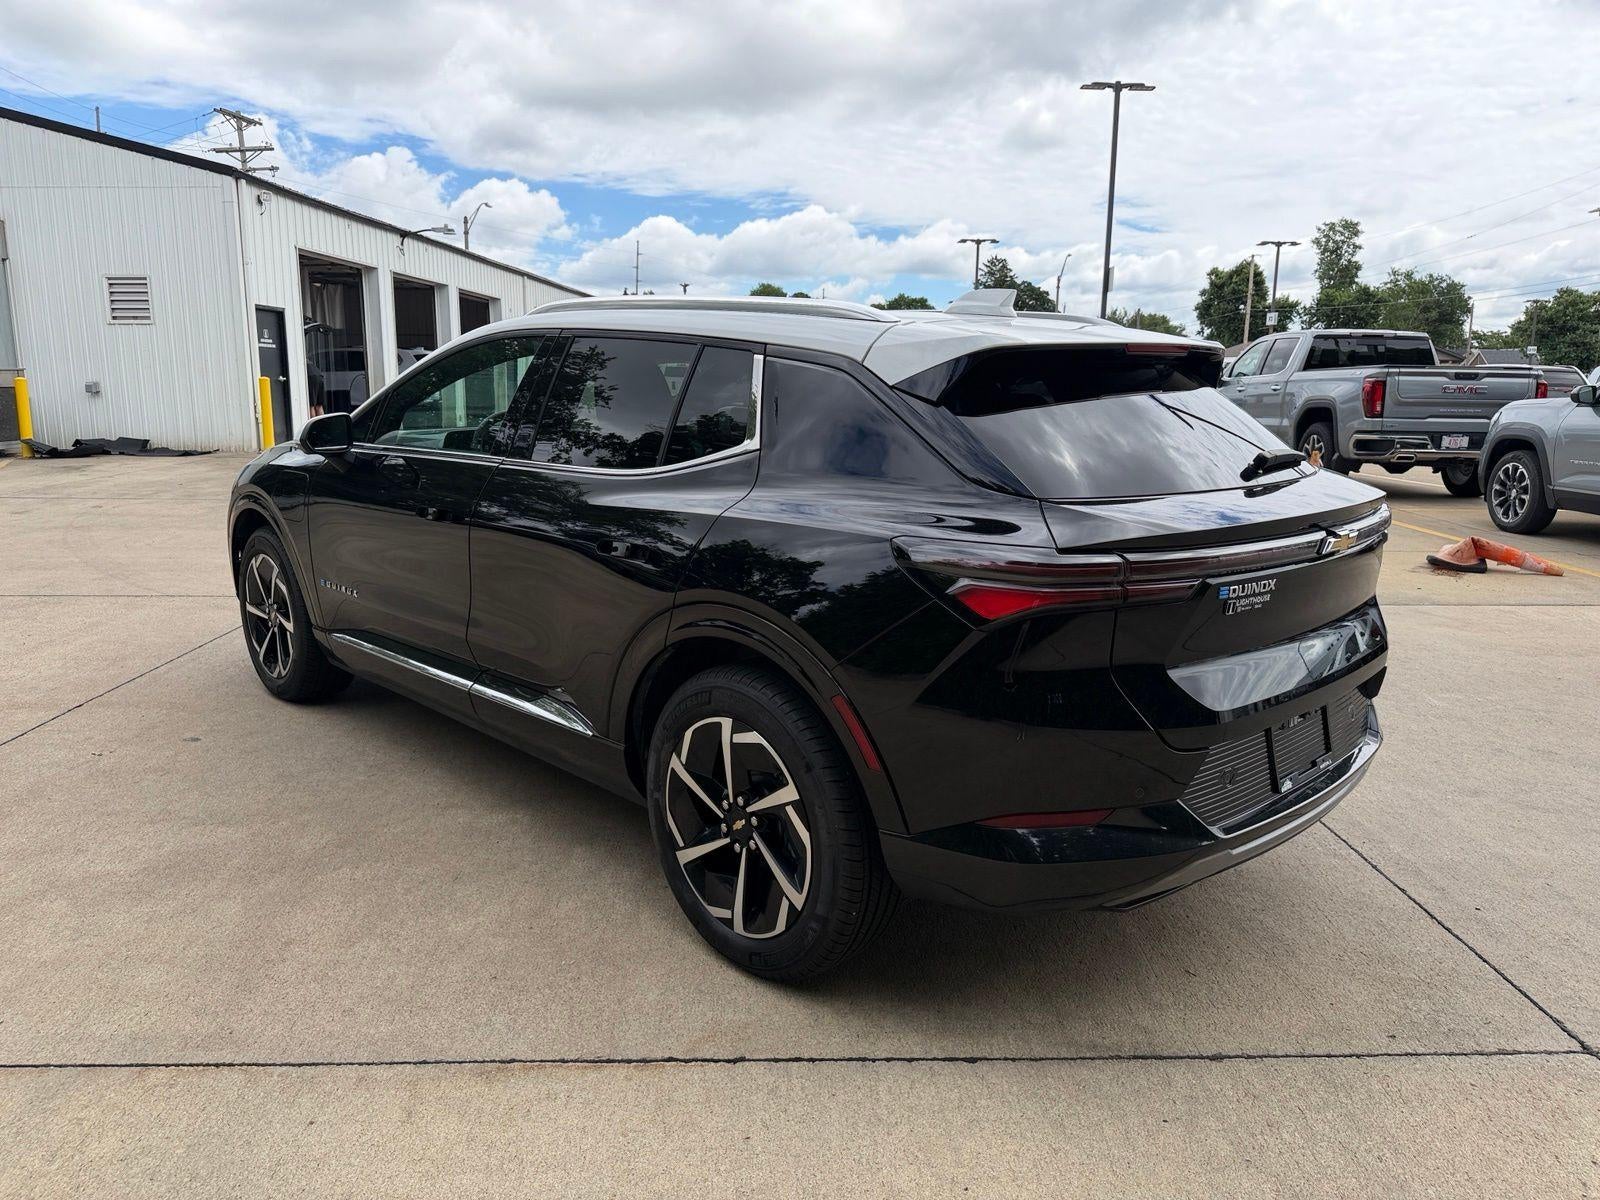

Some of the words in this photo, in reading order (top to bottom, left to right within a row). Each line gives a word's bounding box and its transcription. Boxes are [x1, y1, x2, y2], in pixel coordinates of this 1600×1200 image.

[1441, 384, 1489, 394] GMC
[1218, 578, 1277, 600] EQUINOX
[1236, 593, 1271, 607] LIGHTHOUSE
